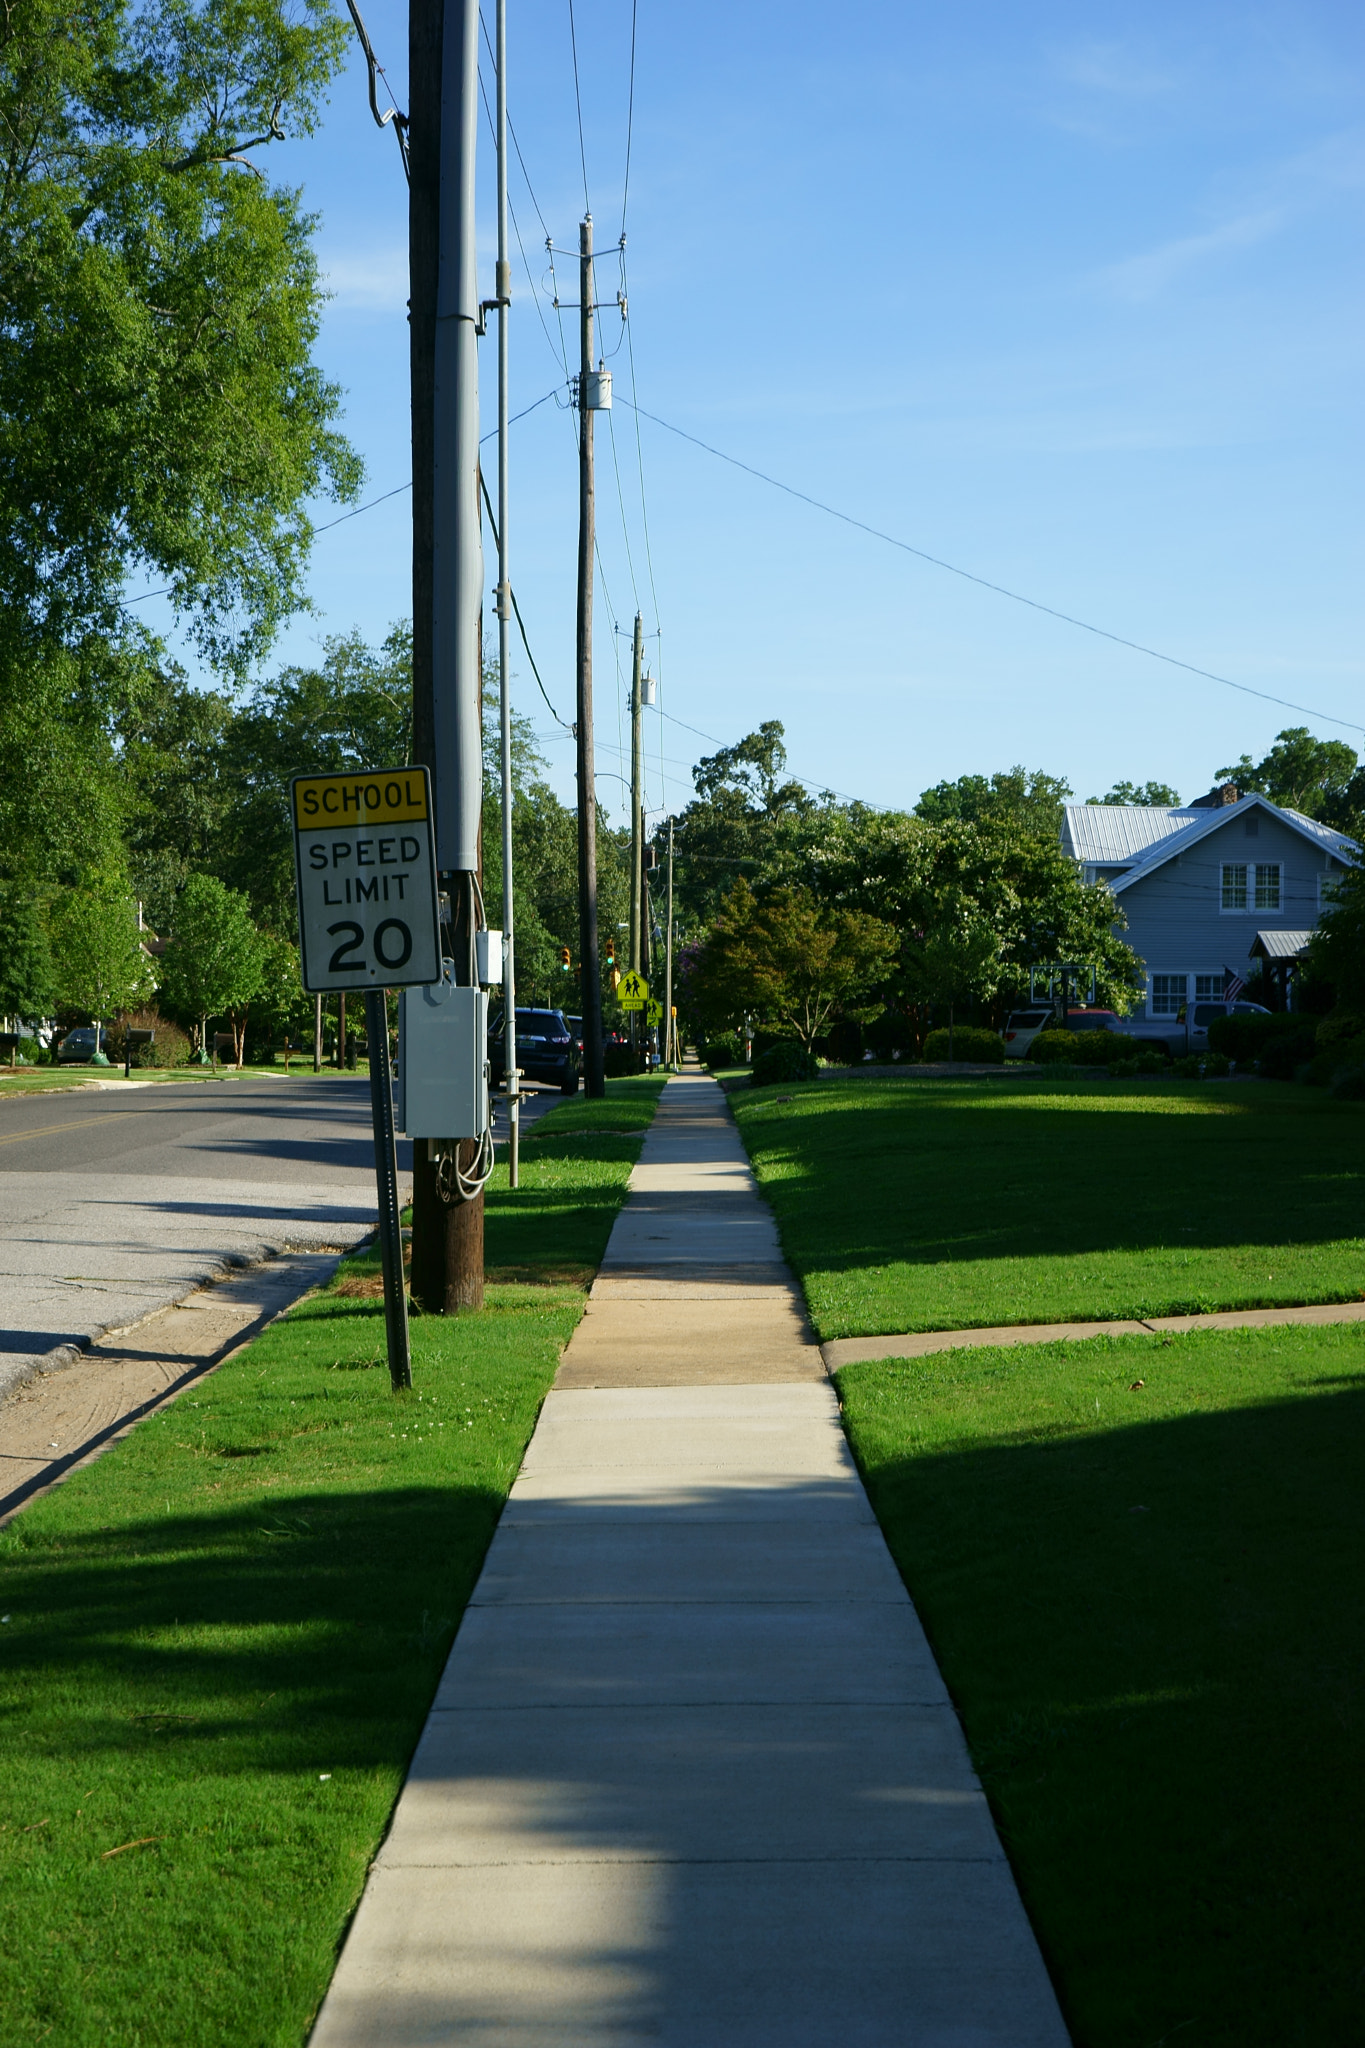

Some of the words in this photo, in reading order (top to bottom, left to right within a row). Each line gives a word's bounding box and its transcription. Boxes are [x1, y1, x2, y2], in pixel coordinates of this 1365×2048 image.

[303, 780, 422, 815] SCHOOL
[309, 836, 421, 870] SPEED
[323, 874, 409, 905] LIMIT
[326, 918, 412, 972] 20
